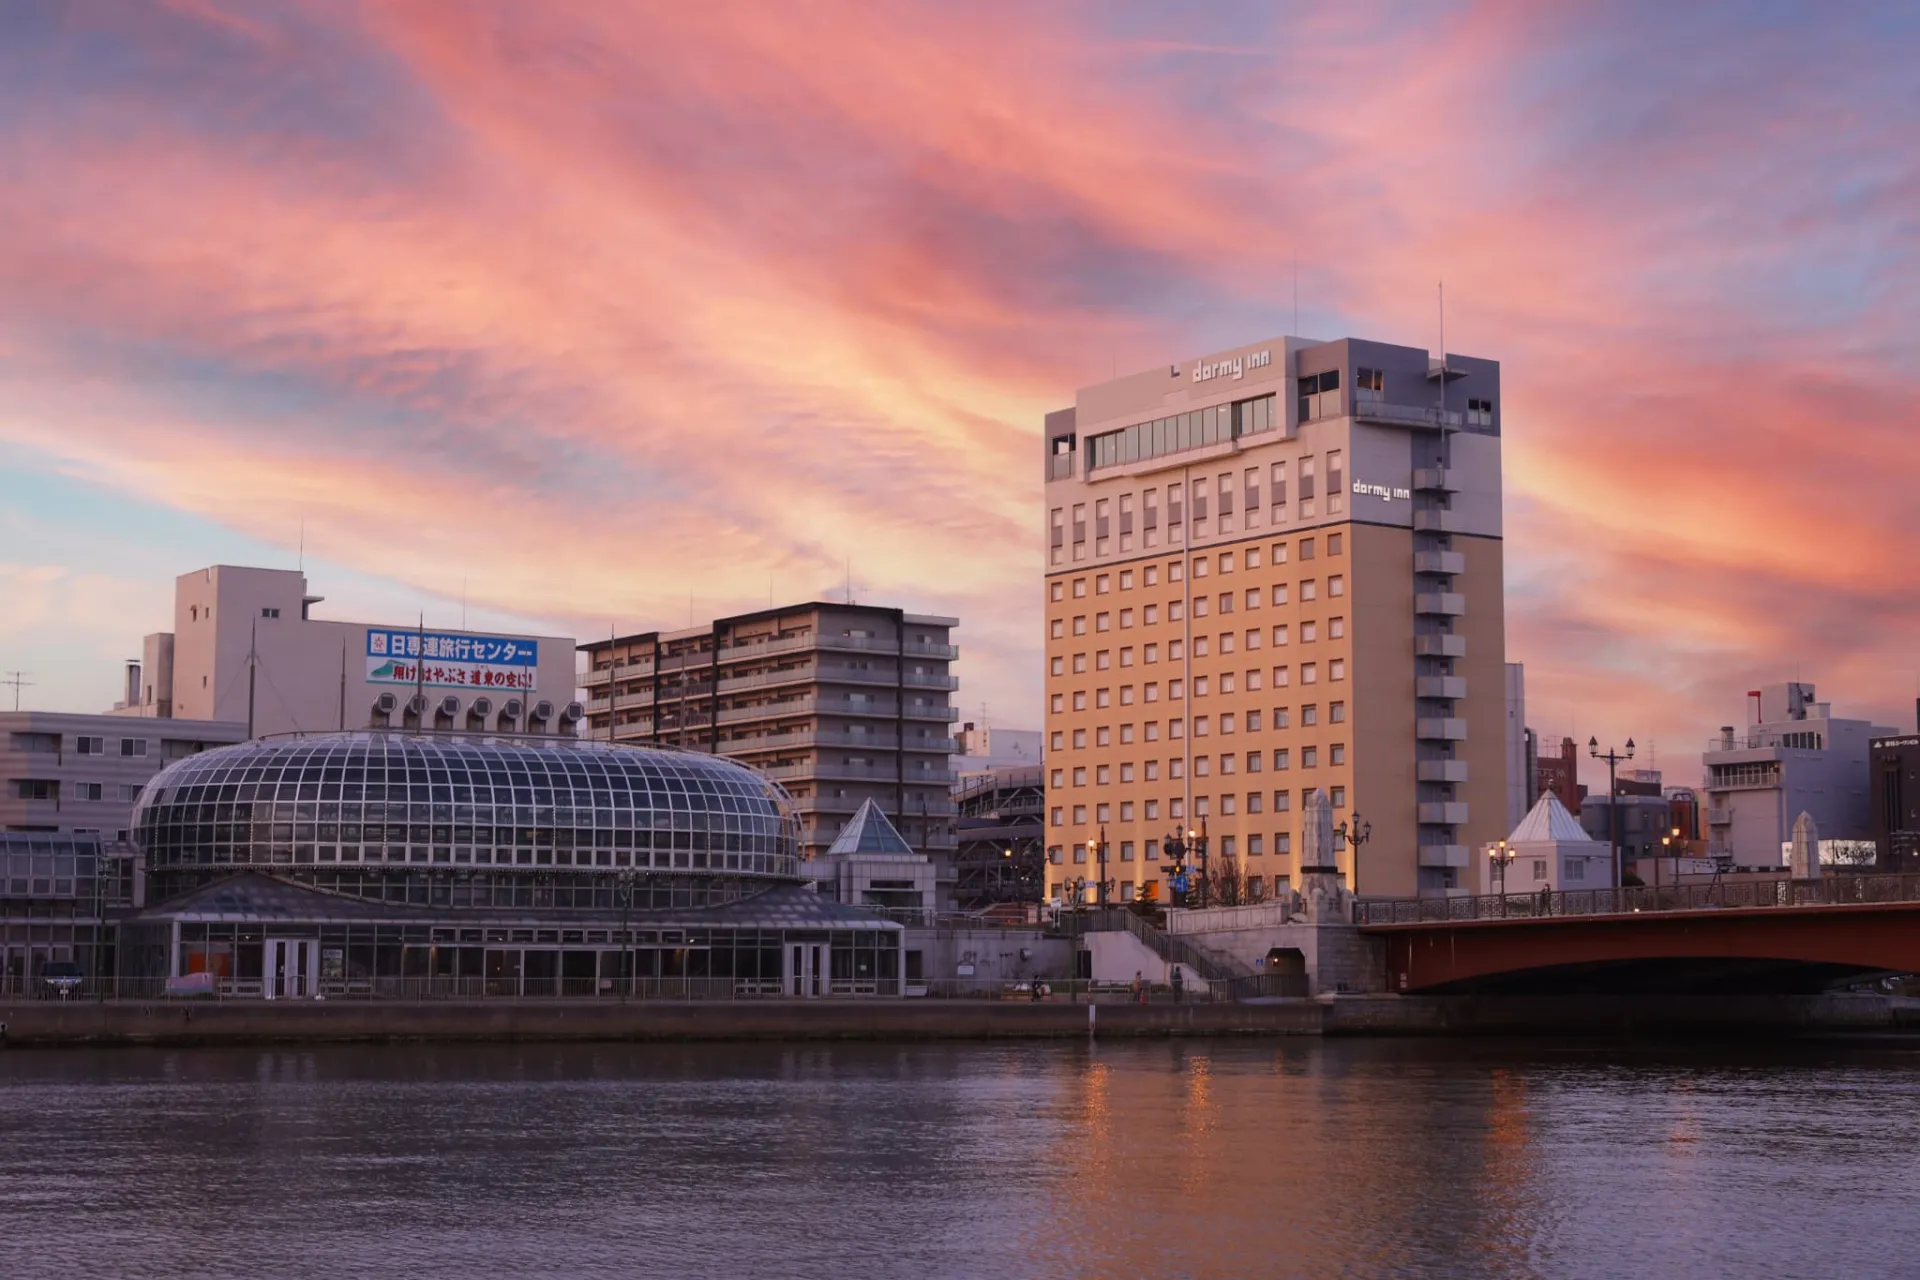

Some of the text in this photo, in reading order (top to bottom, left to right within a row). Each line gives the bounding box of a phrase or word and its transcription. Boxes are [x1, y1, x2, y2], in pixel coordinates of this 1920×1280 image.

[1192, 350, 1271, 383] dormy inn
[1353, 479, 1410, 501] dormy inn
[391, 635, 533, 661] 日専連旅行センター
